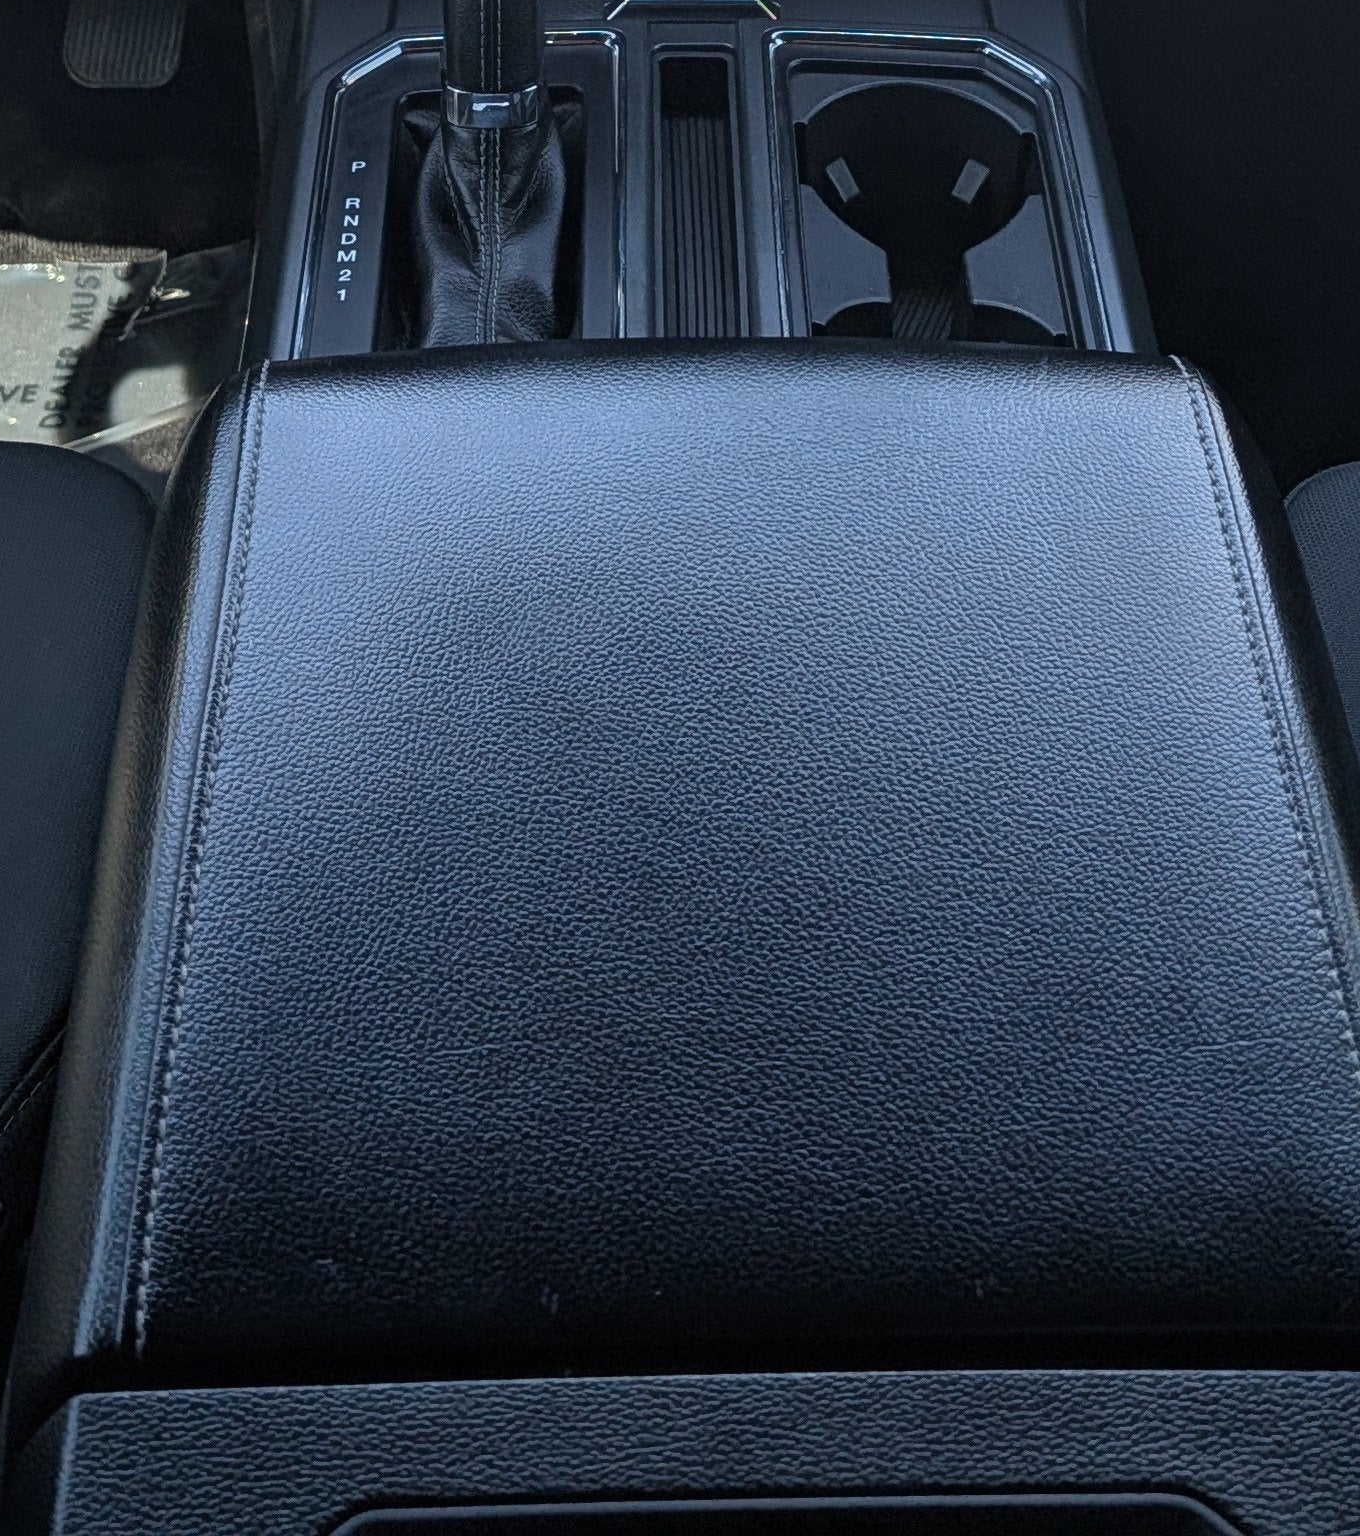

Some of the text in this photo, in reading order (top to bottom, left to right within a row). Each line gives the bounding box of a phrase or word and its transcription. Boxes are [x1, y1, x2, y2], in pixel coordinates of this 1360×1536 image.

[351, 161, 366, 172] P
[345, 198, 360, 209] R
[343, 215, 359, 226] N
[341, 233, 356, 244] D
[337, 250, 356, 262] M
[338, 269, 351, 281] 2
[337, 289, 346, 301] 1
